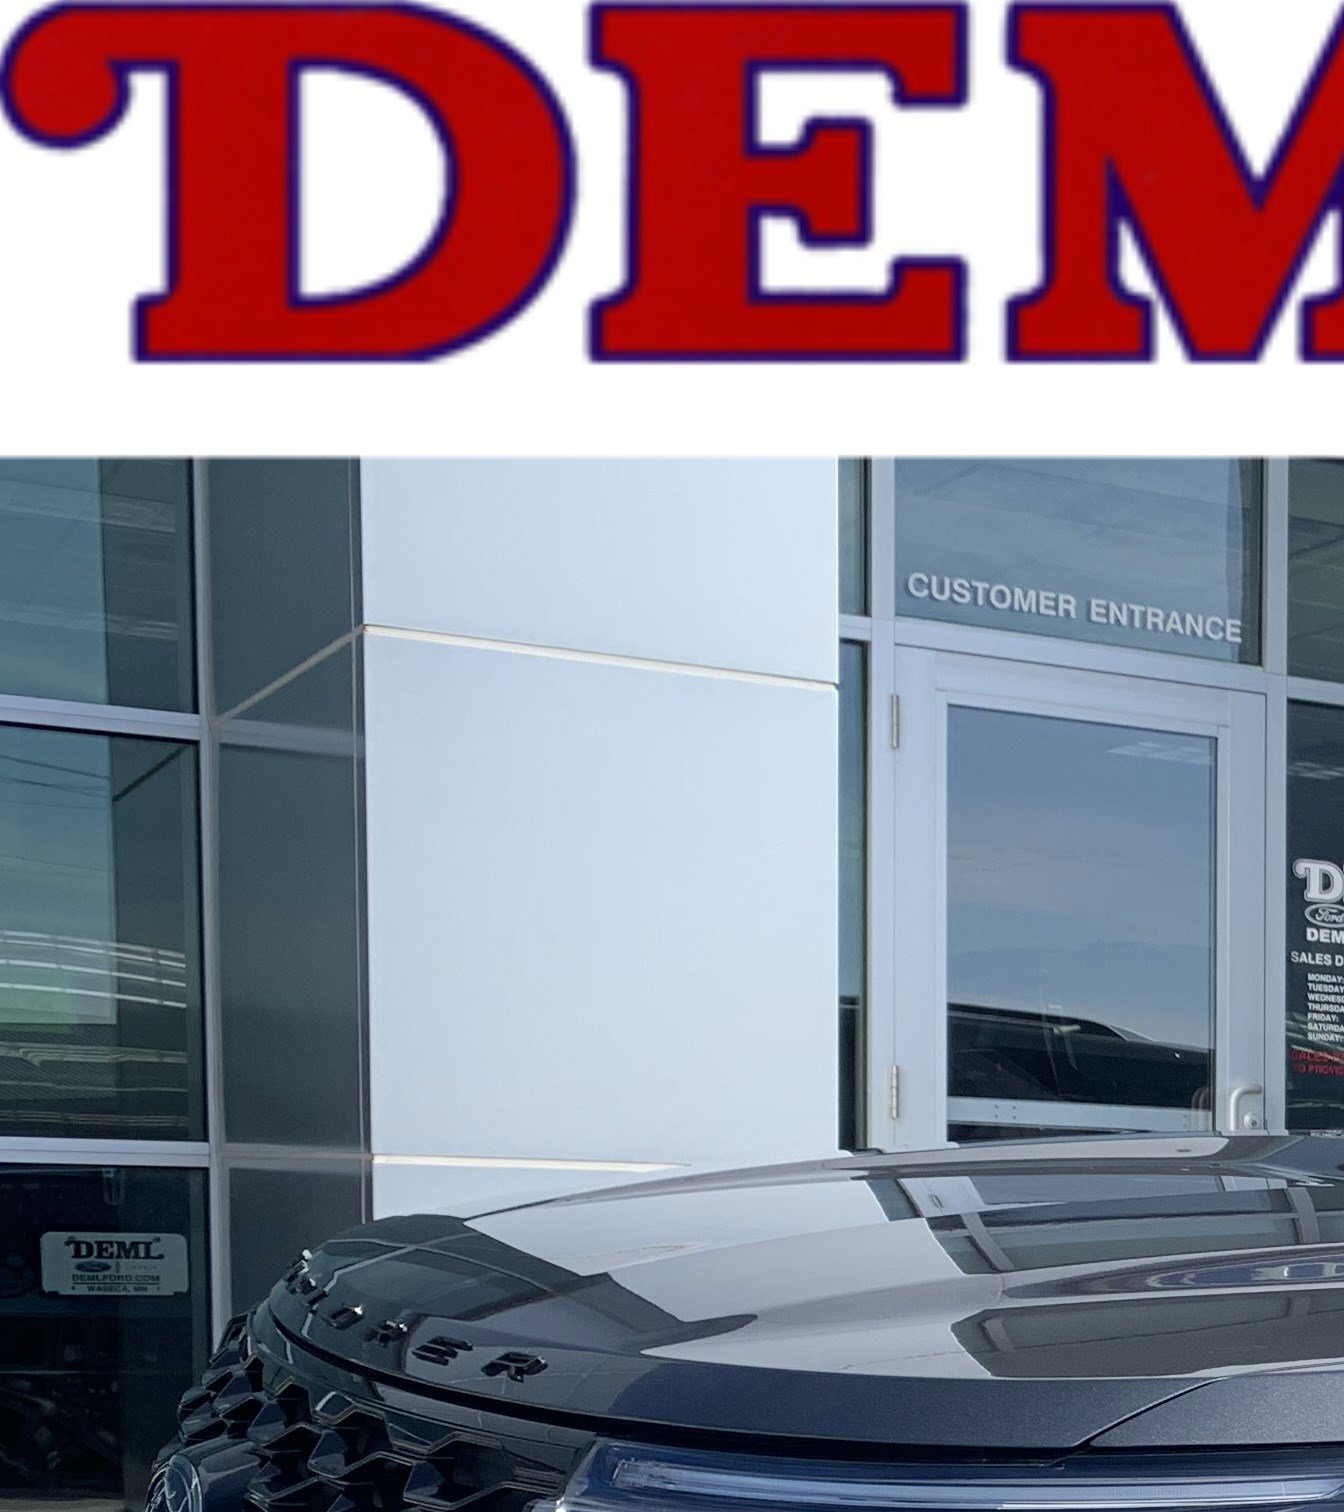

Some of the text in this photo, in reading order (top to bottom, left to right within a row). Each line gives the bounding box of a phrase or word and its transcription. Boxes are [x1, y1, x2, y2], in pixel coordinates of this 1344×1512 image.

[907, 573, 1243, 643] CUSTOMER ENTRANCE
[1315, 907, 1344, 923] Ford
[1290, 951, 1332, 967] SALES
[1307, 973, 1344, 984] MONDAY:
[1307, 1012, 1339, 1023] FRIDAY:
[64, 1240, 165, 1260] DEML
[72, 1273, 160, 1282] DEMLFORD.COM
